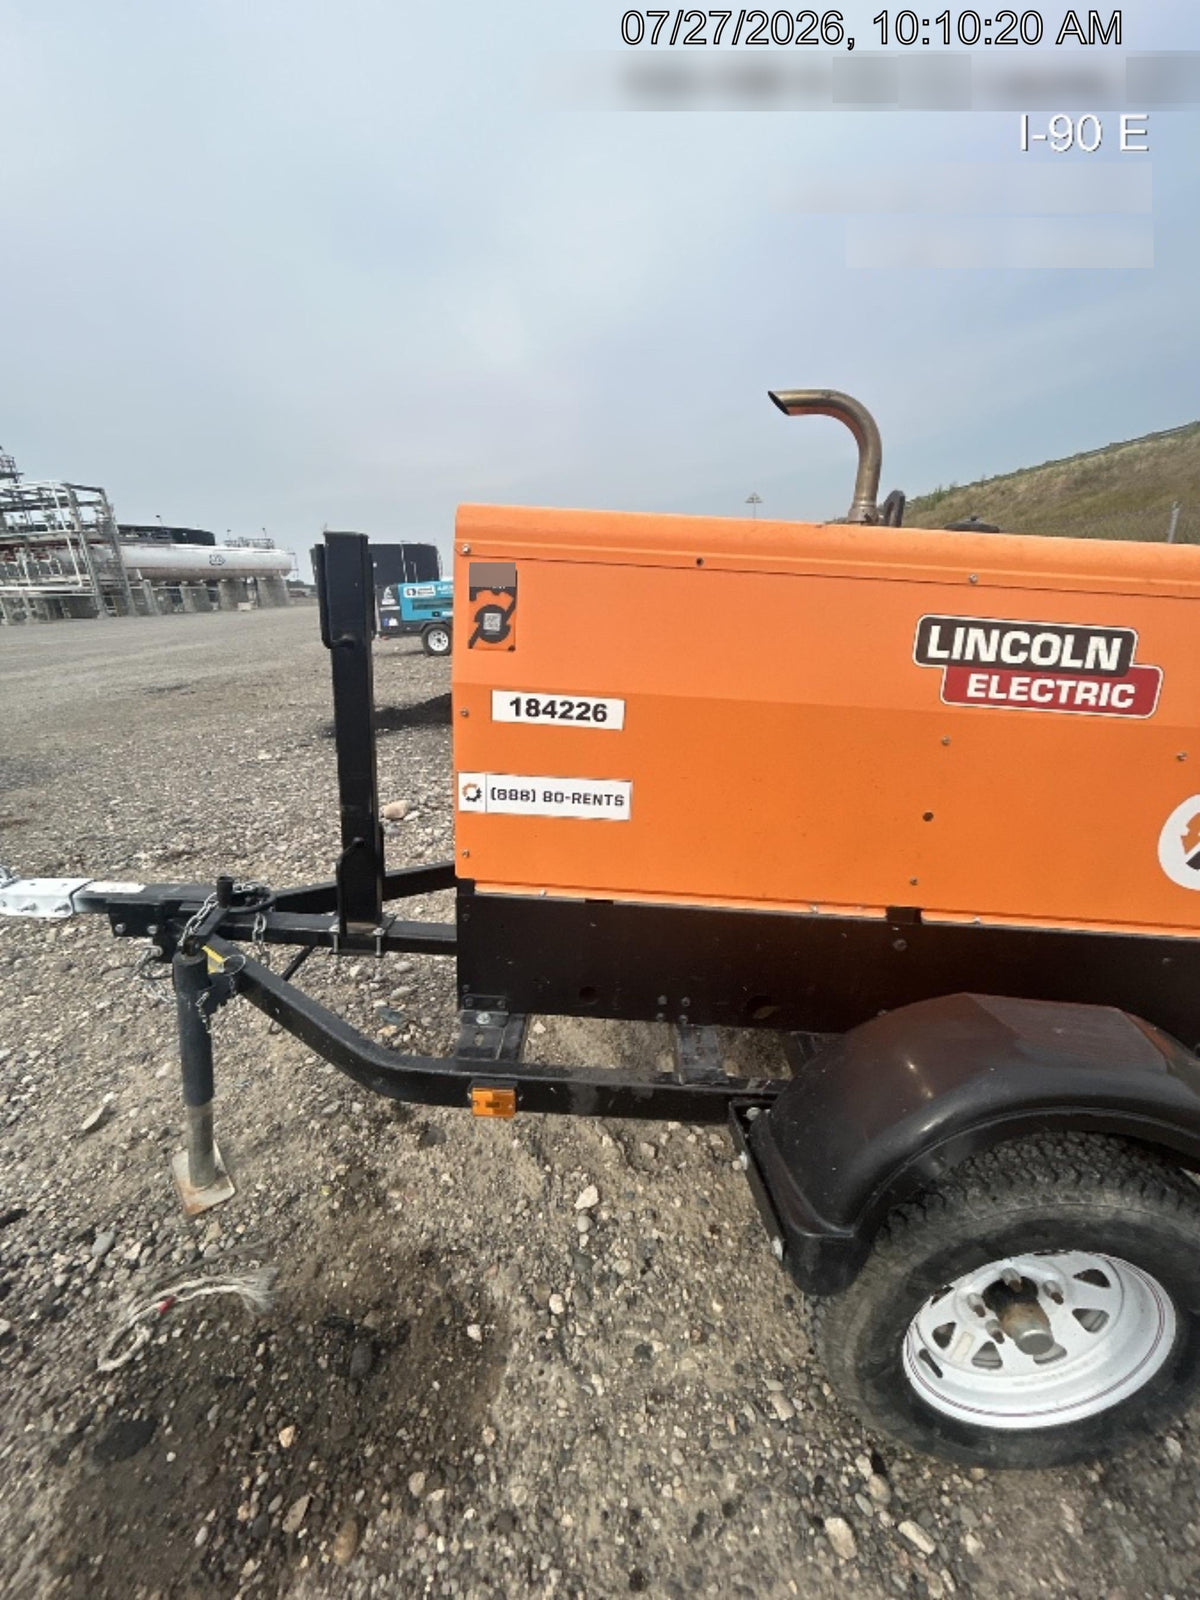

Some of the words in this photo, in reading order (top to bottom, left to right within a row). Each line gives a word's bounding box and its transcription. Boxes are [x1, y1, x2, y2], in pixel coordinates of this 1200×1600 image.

[927, 625, 1122, 670] LINCOLN
[966, 673, 1136, 708] ELECTRIC
[509, 696, 608, 723] 184226
[490, 787, 536, 803] (888)
